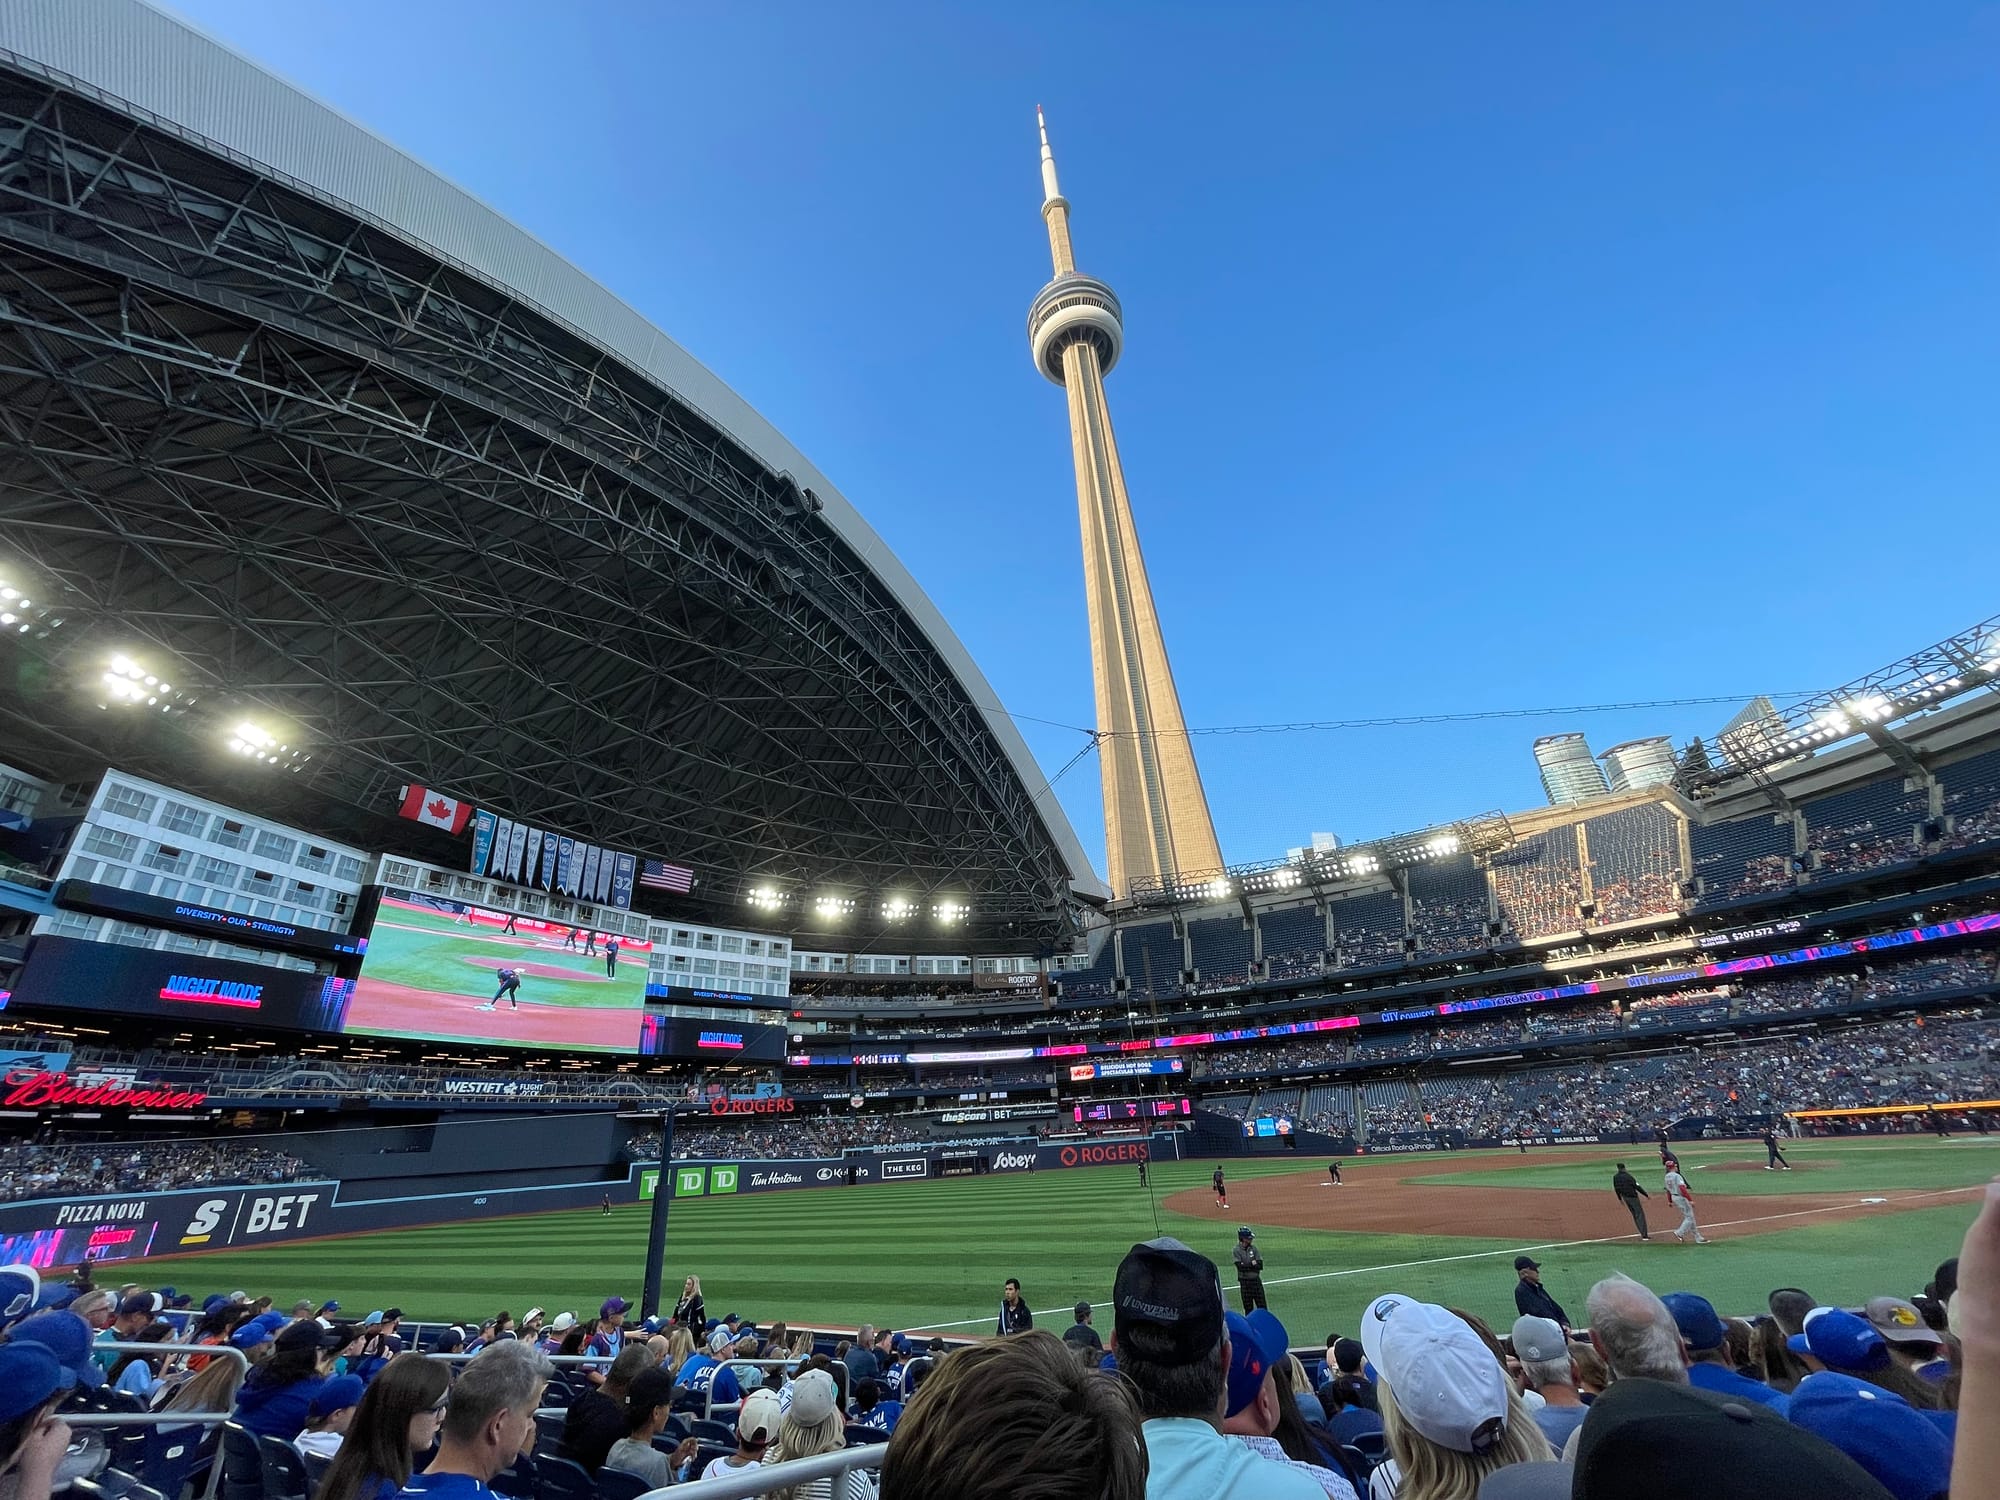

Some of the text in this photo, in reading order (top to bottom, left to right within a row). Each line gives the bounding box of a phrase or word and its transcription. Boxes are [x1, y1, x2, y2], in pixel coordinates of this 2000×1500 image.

[614, 875, 632, 891] 32
[175, 906, 296, 936] DIVERSITY OUR STRENGTH
[1008, 975, 1038, 984] ROOFTOP
[1627, 975, 1649, 988] CITY
[167, 975, 263, 1001] NIGHT MODE
[1492, 991, 1543, 1006] TORONTO
[1381, 1011, 1399, 1022] CITY
[700, 1031, 743, 1044] NIGHT MODE
[4, 1068, 208, 1109] Budweiser
[520, 1083, 544, 1091] FLIGHT
[732, 1098, 795, 1113] ROGERS
[941, 1112, 987, 1122] theScore
[994, 1110, 1011, 1119] BET
[1246, 1126, 1255, 1137] 3
[993, 1151, 1037, 1170] Sobeys
[1081, 1143, 1148, 1163] ROGERS
[887, 1164, 922, 1173] THE KEG
[680, 1172, 702, 1191] TD
[713, 1170, 735, 1188] TD
[751, 1171, 802, 1187] Tim Hortons
[473, 1197, 487, 1205] 400
[55, 1201, 146, 1226] PIZZA NOVA
[246, 1194, 319, 1234] BET
[1131, 1299, 1179, 1315] UNIVERSAL
